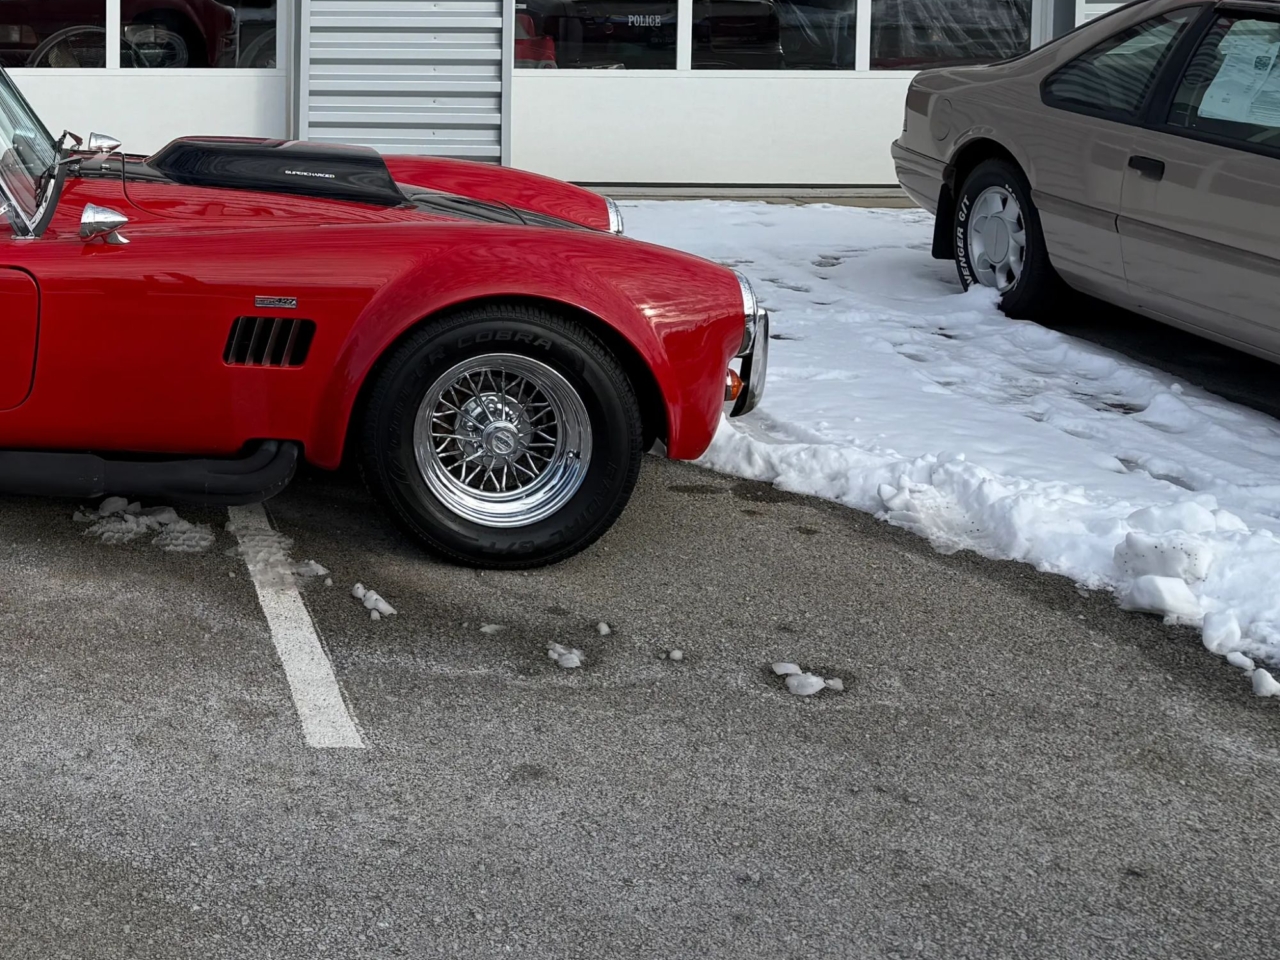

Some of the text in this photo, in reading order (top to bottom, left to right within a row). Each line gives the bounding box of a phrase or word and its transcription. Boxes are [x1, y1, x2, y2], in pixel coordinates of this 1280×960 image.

[627, 14, 662, 27] POLICE
[956, 227, 975, 287] VENGER
[457, 330, 553, 351] COBRA
